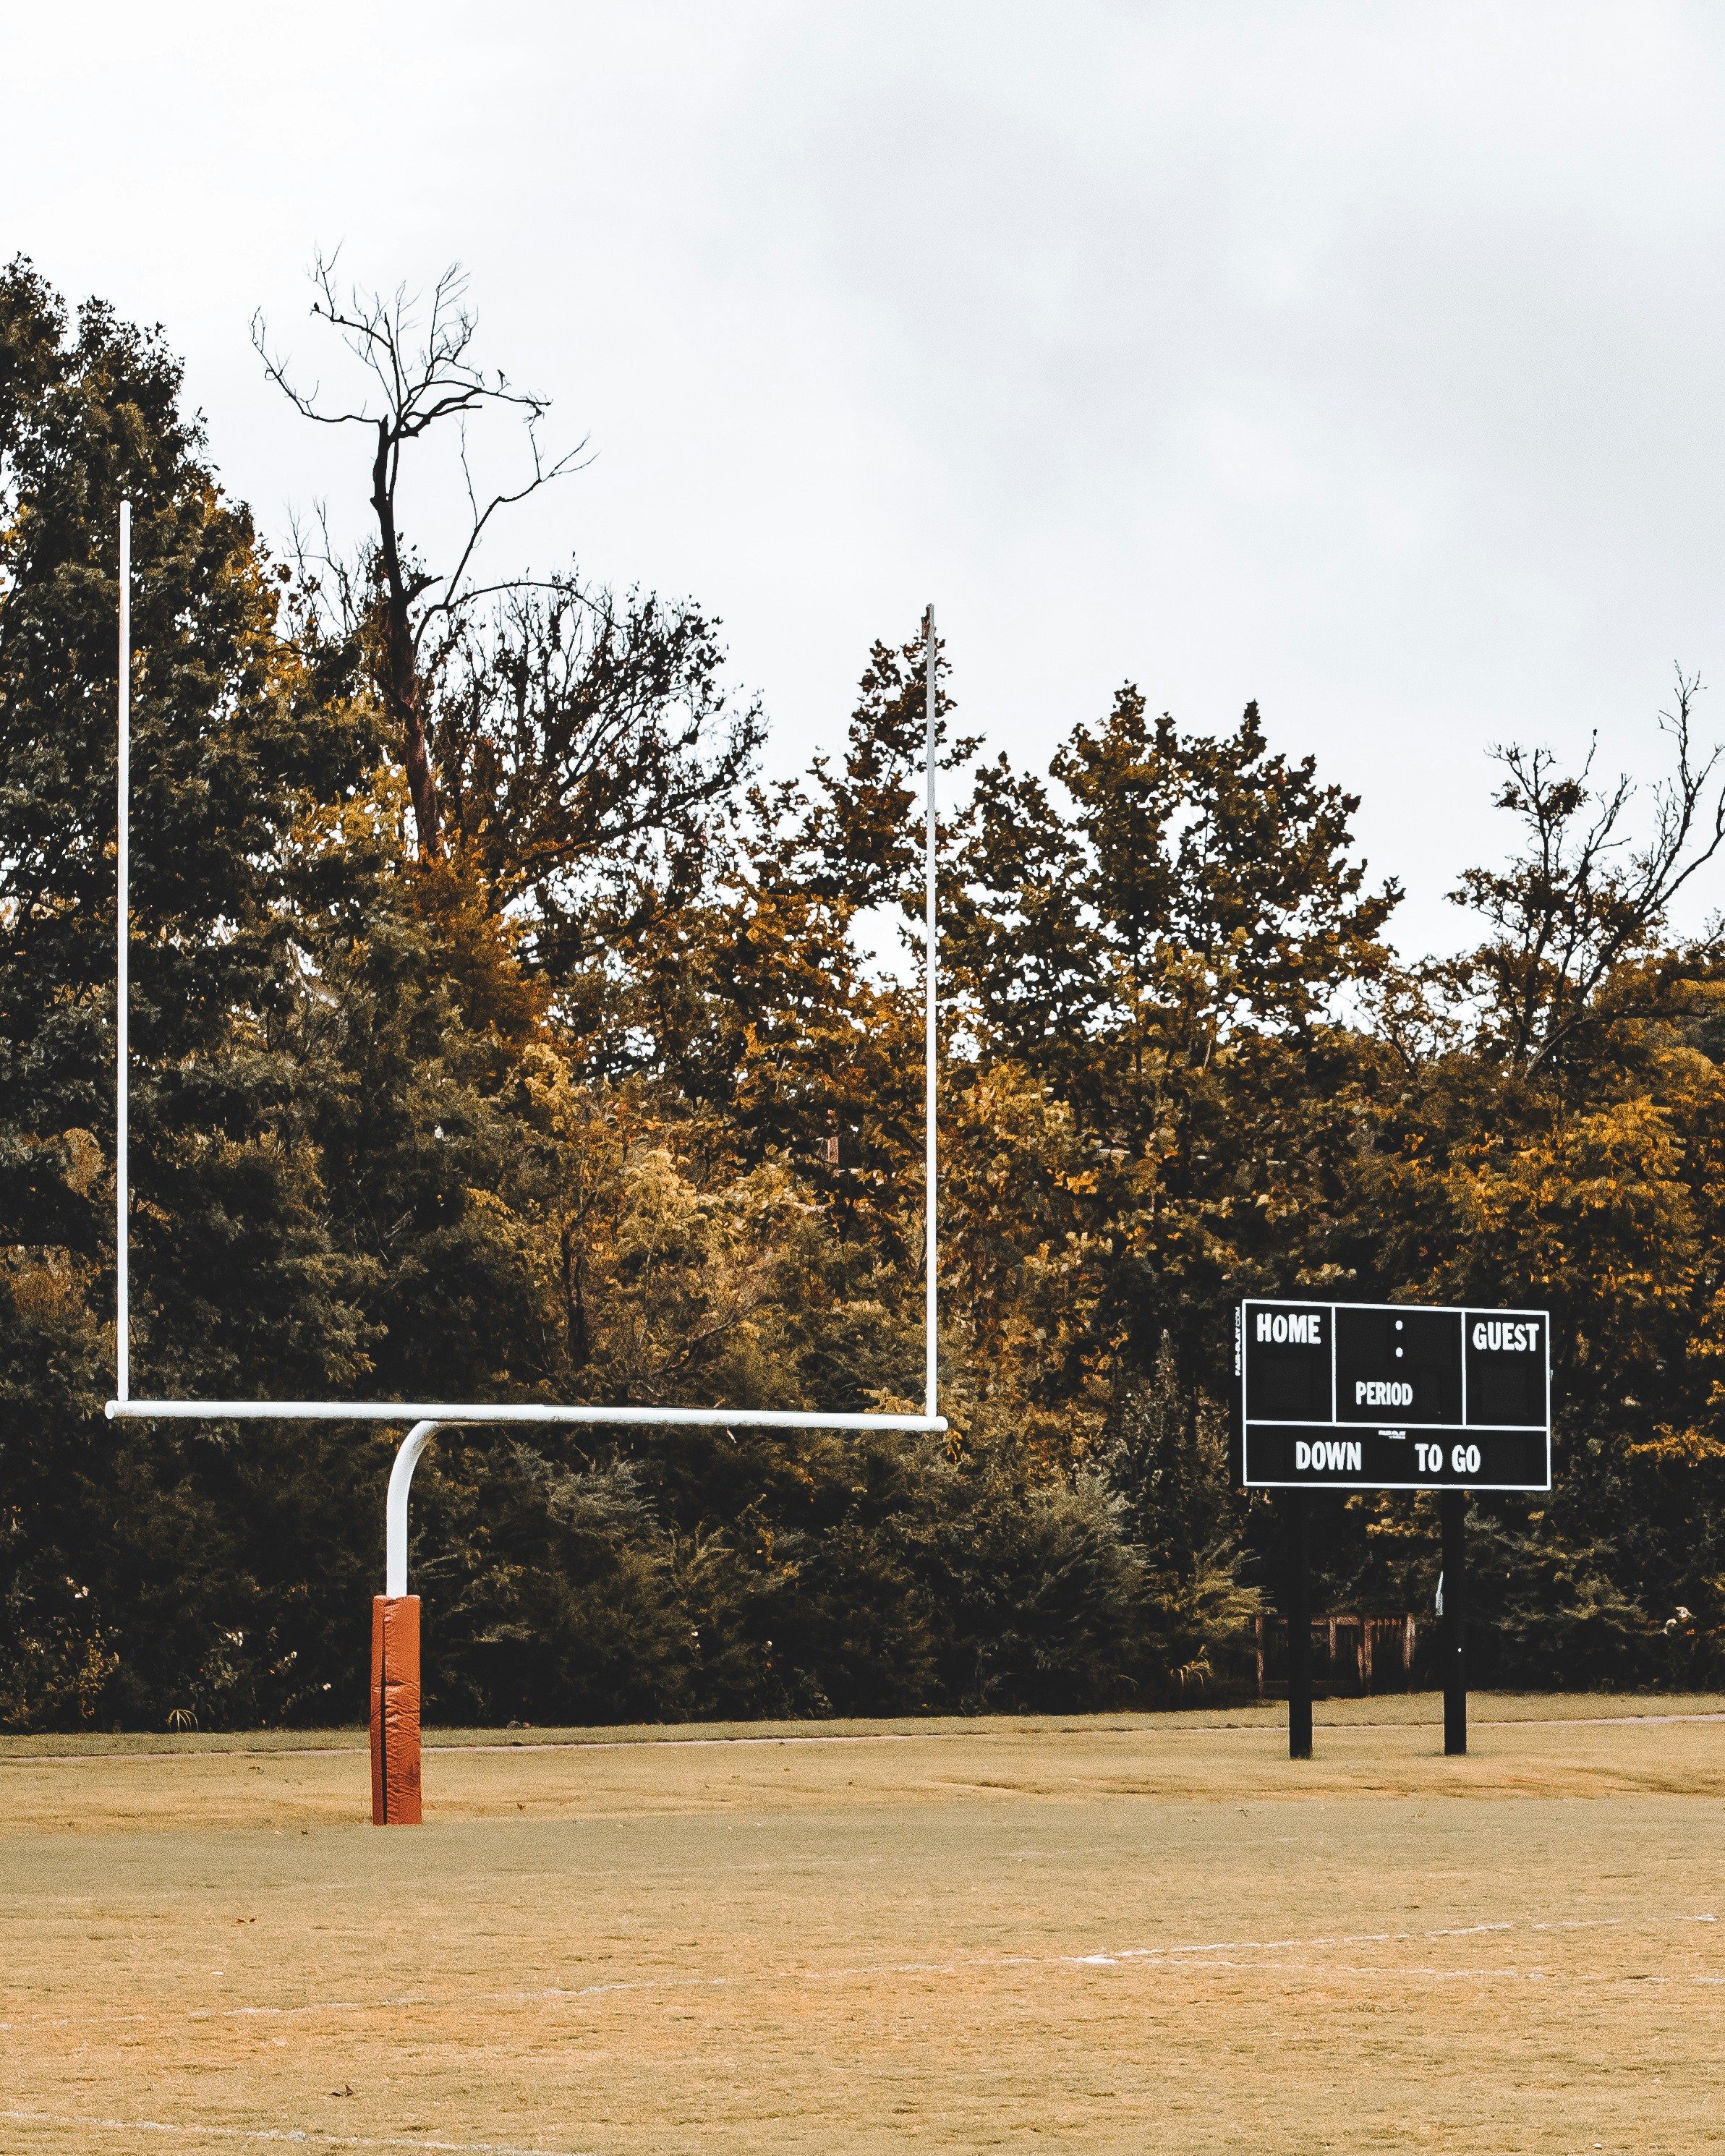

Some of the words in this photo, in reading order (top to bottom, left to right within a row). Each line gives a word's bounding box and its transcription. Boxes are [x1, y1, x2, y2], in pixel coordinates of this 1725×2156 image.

[1257, 1313, 1321, 1345] HOME
[1473, 1322, 1540, 1352] GUEST
[1356, 1381, 1413, 1406] PERIOD
[1295, 1441, 1362, 1471] DOWN
[1415, 1443, 1444, 1473] TO
[1452, 1445, 1481, 1473] GO
